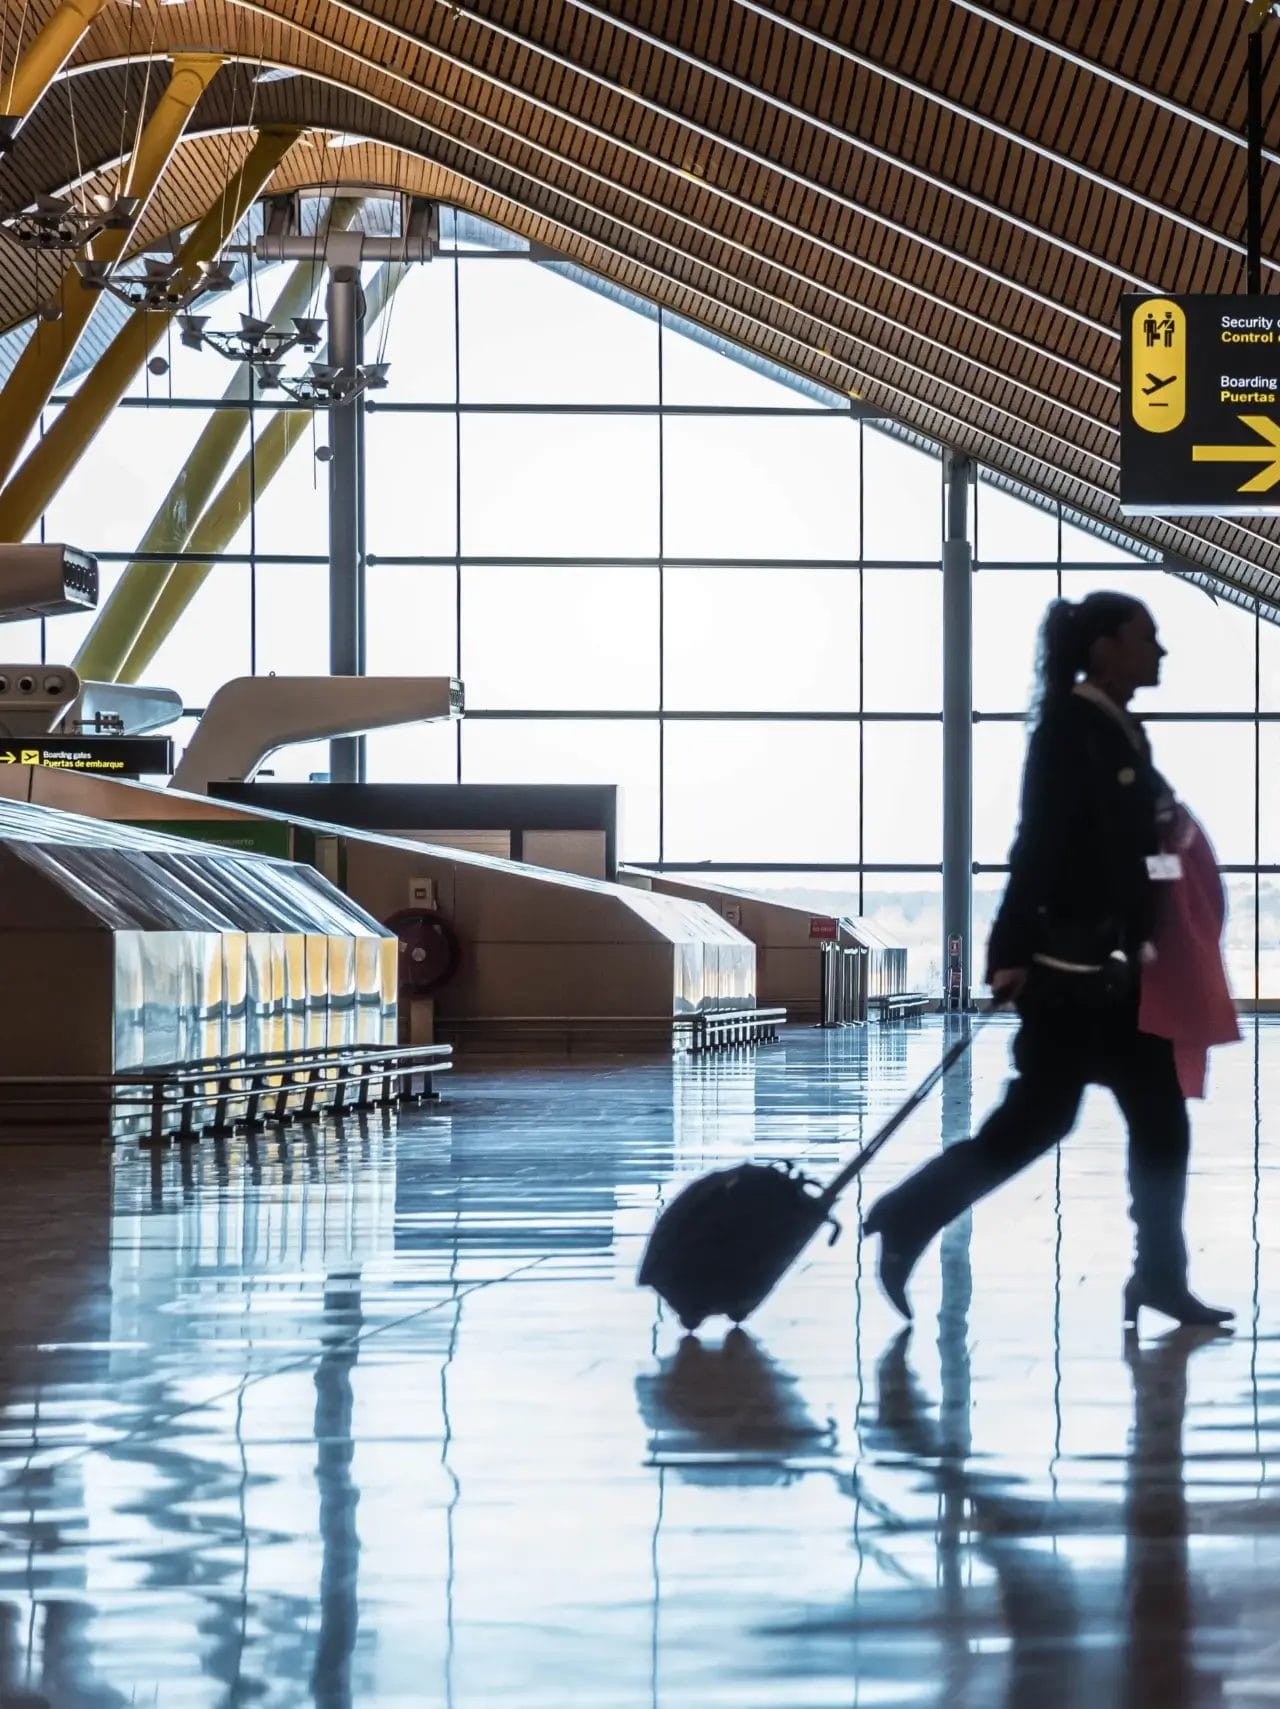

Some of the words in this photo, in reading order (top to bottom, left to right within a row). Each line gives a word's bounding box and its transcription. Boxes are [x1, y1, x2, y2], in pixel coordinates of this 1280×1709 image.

[1221, 315, 1273, 330] Security
[1221, 331, 1273, 343] Control
[1220, 375, 1278, 390] Boarding
[1220, 391, 1276, 403] Puertas
[43, 751, 73, 760] Boarding
[73, 752, 92, 760] gates
[43, 760, 74, 768] Puertas
[75, 760, 85, 768] de
[86, 760, 125, 769] embarque
